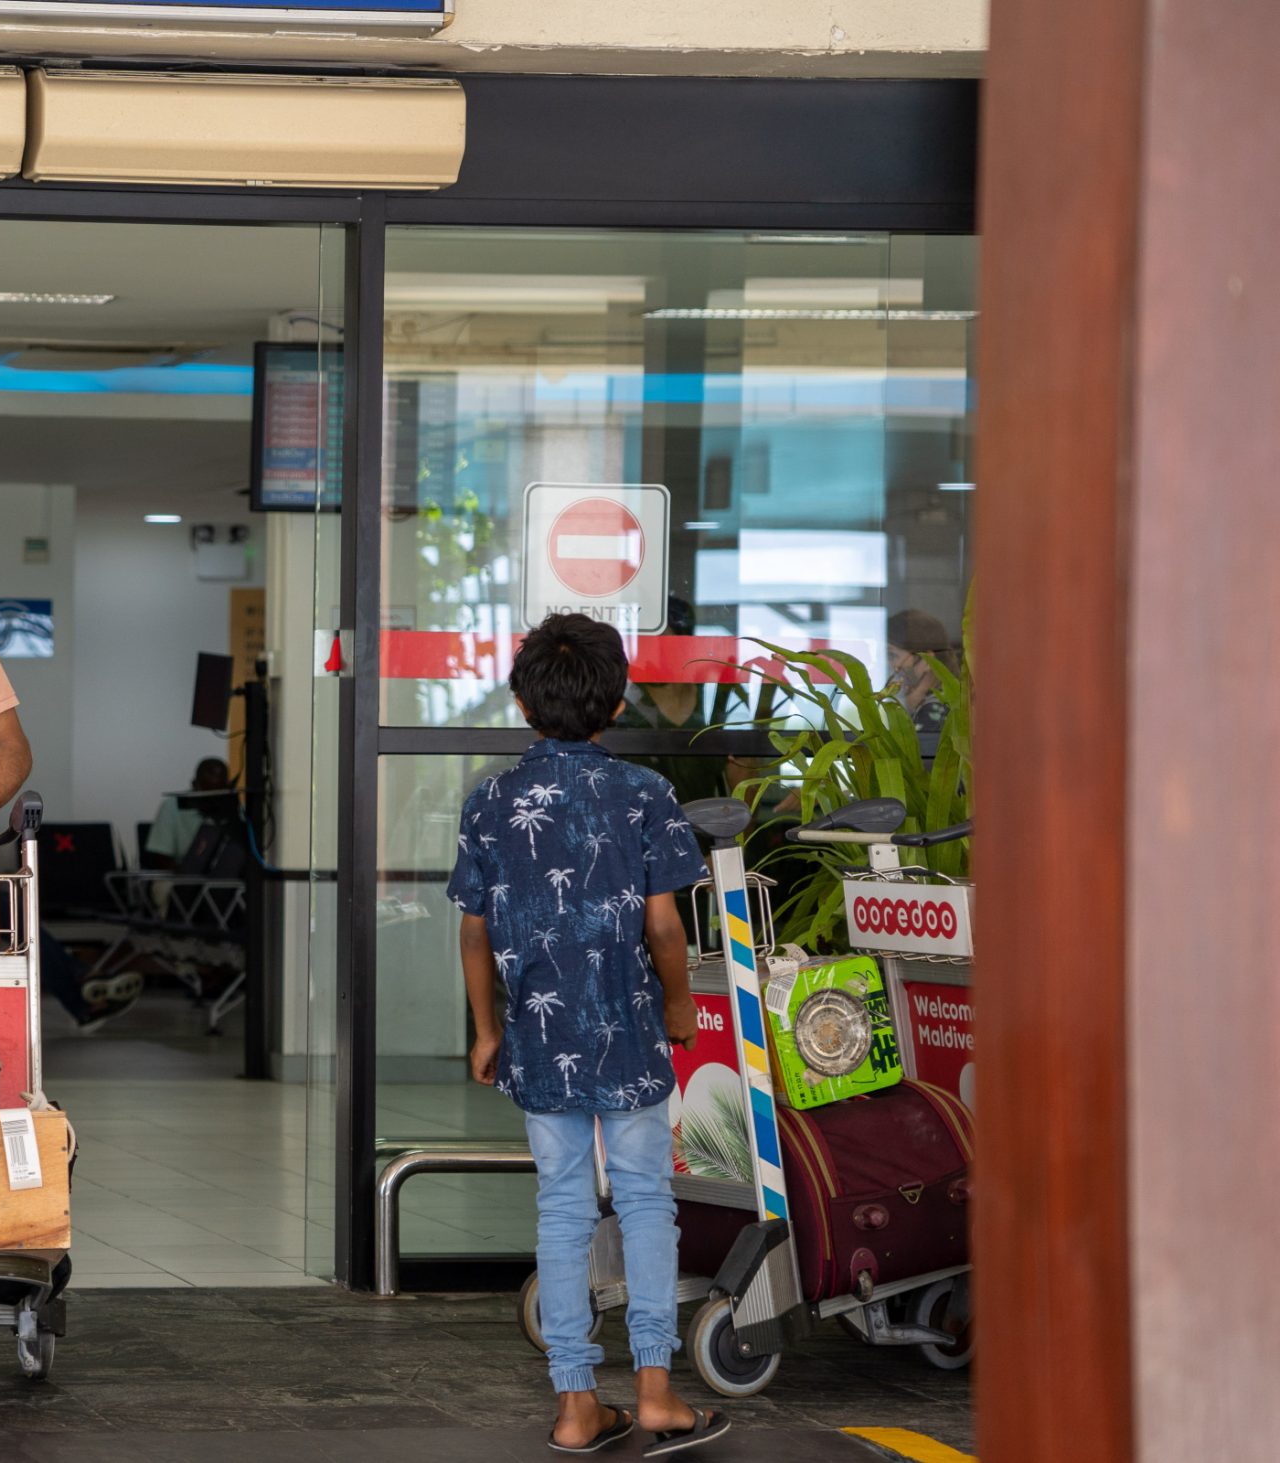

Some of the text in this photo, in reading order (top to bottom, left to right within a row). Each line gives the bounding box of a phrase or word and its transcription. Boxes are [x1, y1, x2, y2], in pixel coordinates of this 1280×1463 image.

[855, 899, 956, 936] ooredoo
[697, 1006, 724, 1031] the
[914, 994, 976, 1022] Welcom
[919, 1023, 974, 1050] Maldive
